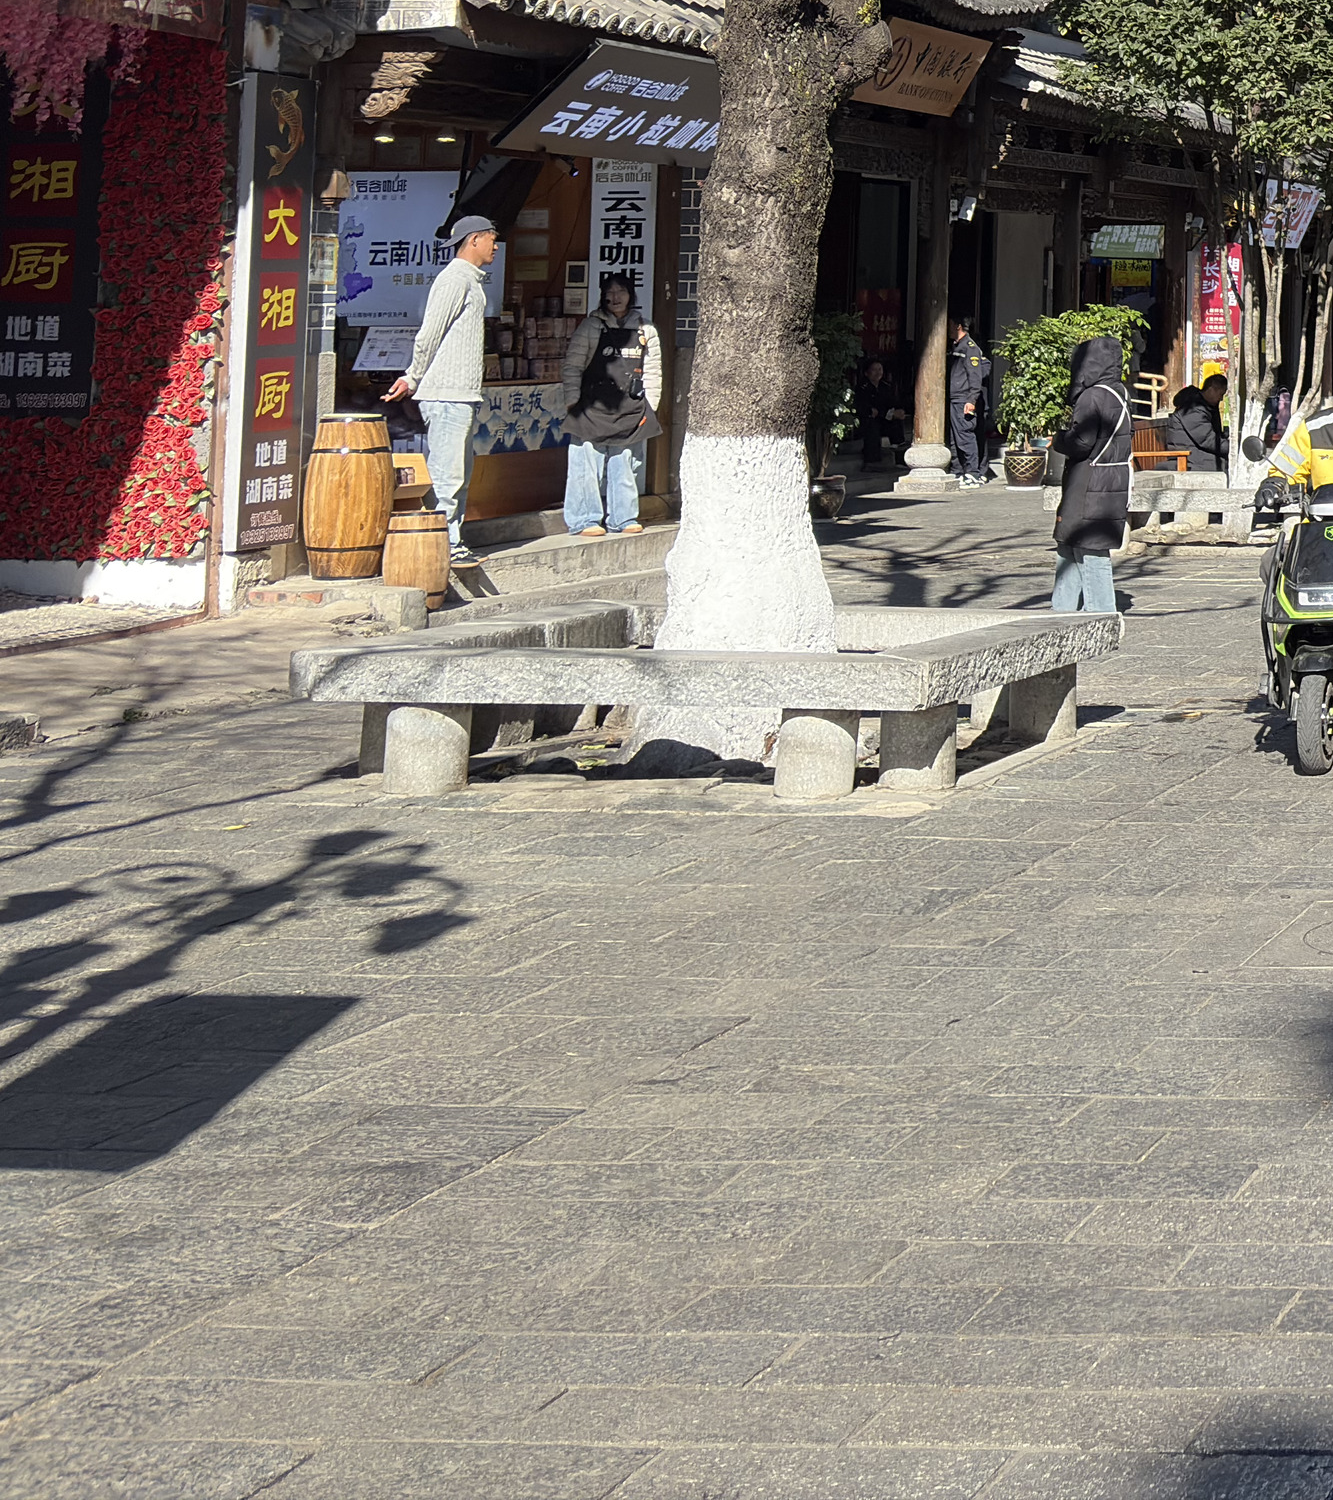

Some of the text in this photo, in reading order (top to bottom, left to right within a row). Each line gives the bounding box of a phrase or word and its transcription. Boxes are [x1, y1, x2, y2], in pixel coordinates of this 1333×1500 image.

[912, 41, 973, 85] 中国银行
[600, 84, 629, 94] COFFEE
[609, 73, 642, 86] HOGOOD
[629, 76, 690, 102] 后谷咖啡
[357, 174, 408, 193] 后谷咖啡
[595, 169, 653, 183] 后谷咖啡
[255, 198, 299, 419] 大湘厨
[6, 315, 60, 342] 地道
[255, 439, 287, 468] 地道
[245, 474, 294, 505] 湖南菜
